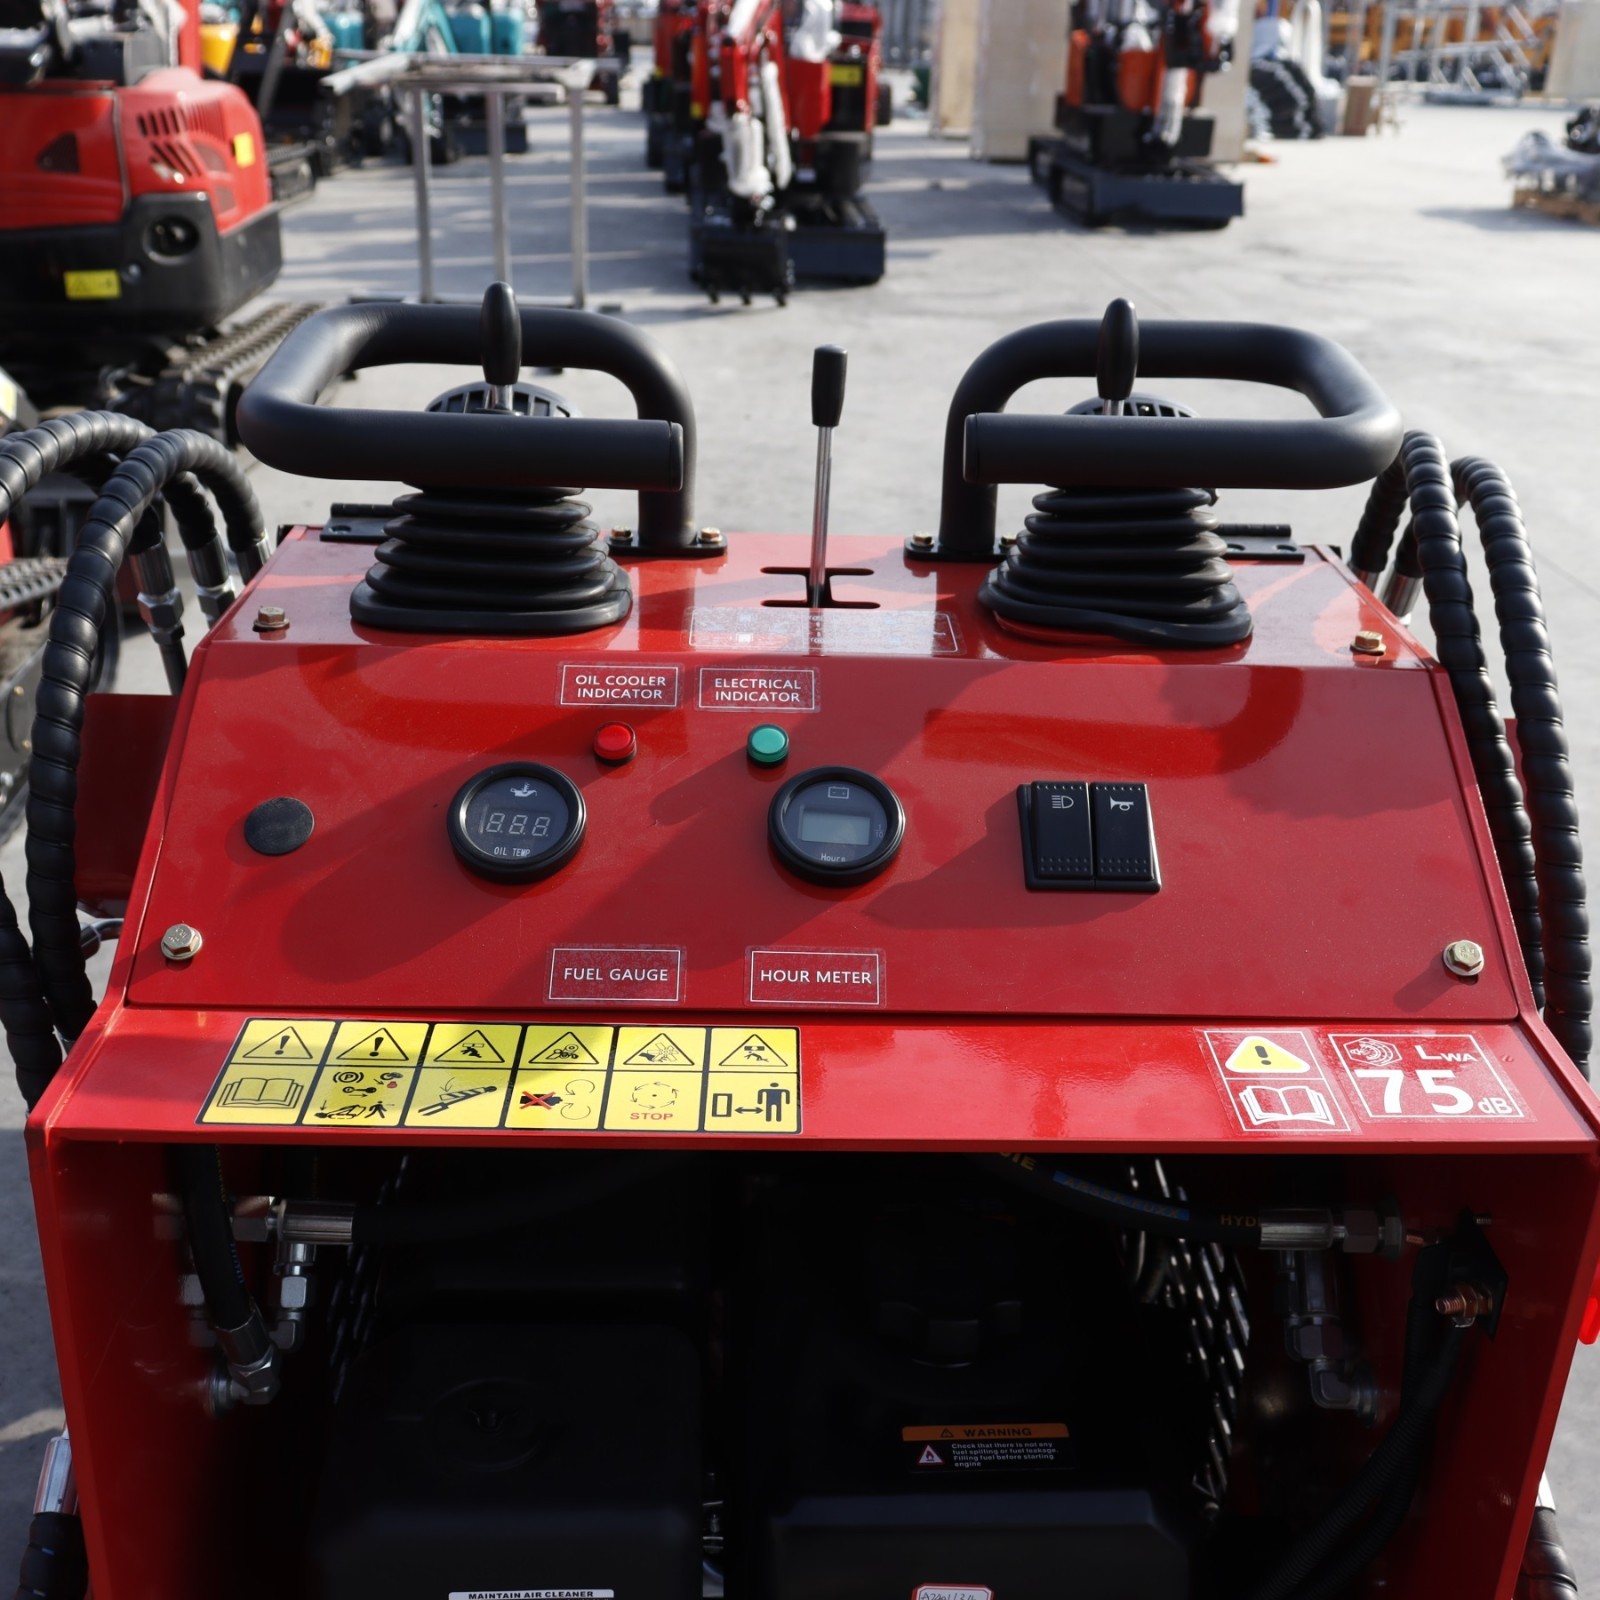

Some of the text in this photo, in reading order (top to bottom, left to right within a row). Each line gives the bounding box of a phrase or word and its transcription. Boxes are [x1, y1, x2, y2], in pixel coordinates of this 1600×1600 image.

[575, 674, 666, 687] OIL COOLER
[715, 678, 801, 690] ELECTRICAL
[577, 687, 663, 699] INDICATOR
[715, 691, 800, 702] INDICATOR
[493, 846, 531, 857] OIL TEMP
[820, 852, 846, 863] Hours
[564, 967, 668, 982] FUEL GAUGE
[760, 969, 872, 984] HOUR METER
[1354, 1069, 1474, 1114] 75
[630, 1112, 674, 1120] STOP
[963, 1427, 1032, 1437] WARNING
[1023, 1453, 1054, 1461] starting
[468, 1592, 521, 1600] MAINTAIN
